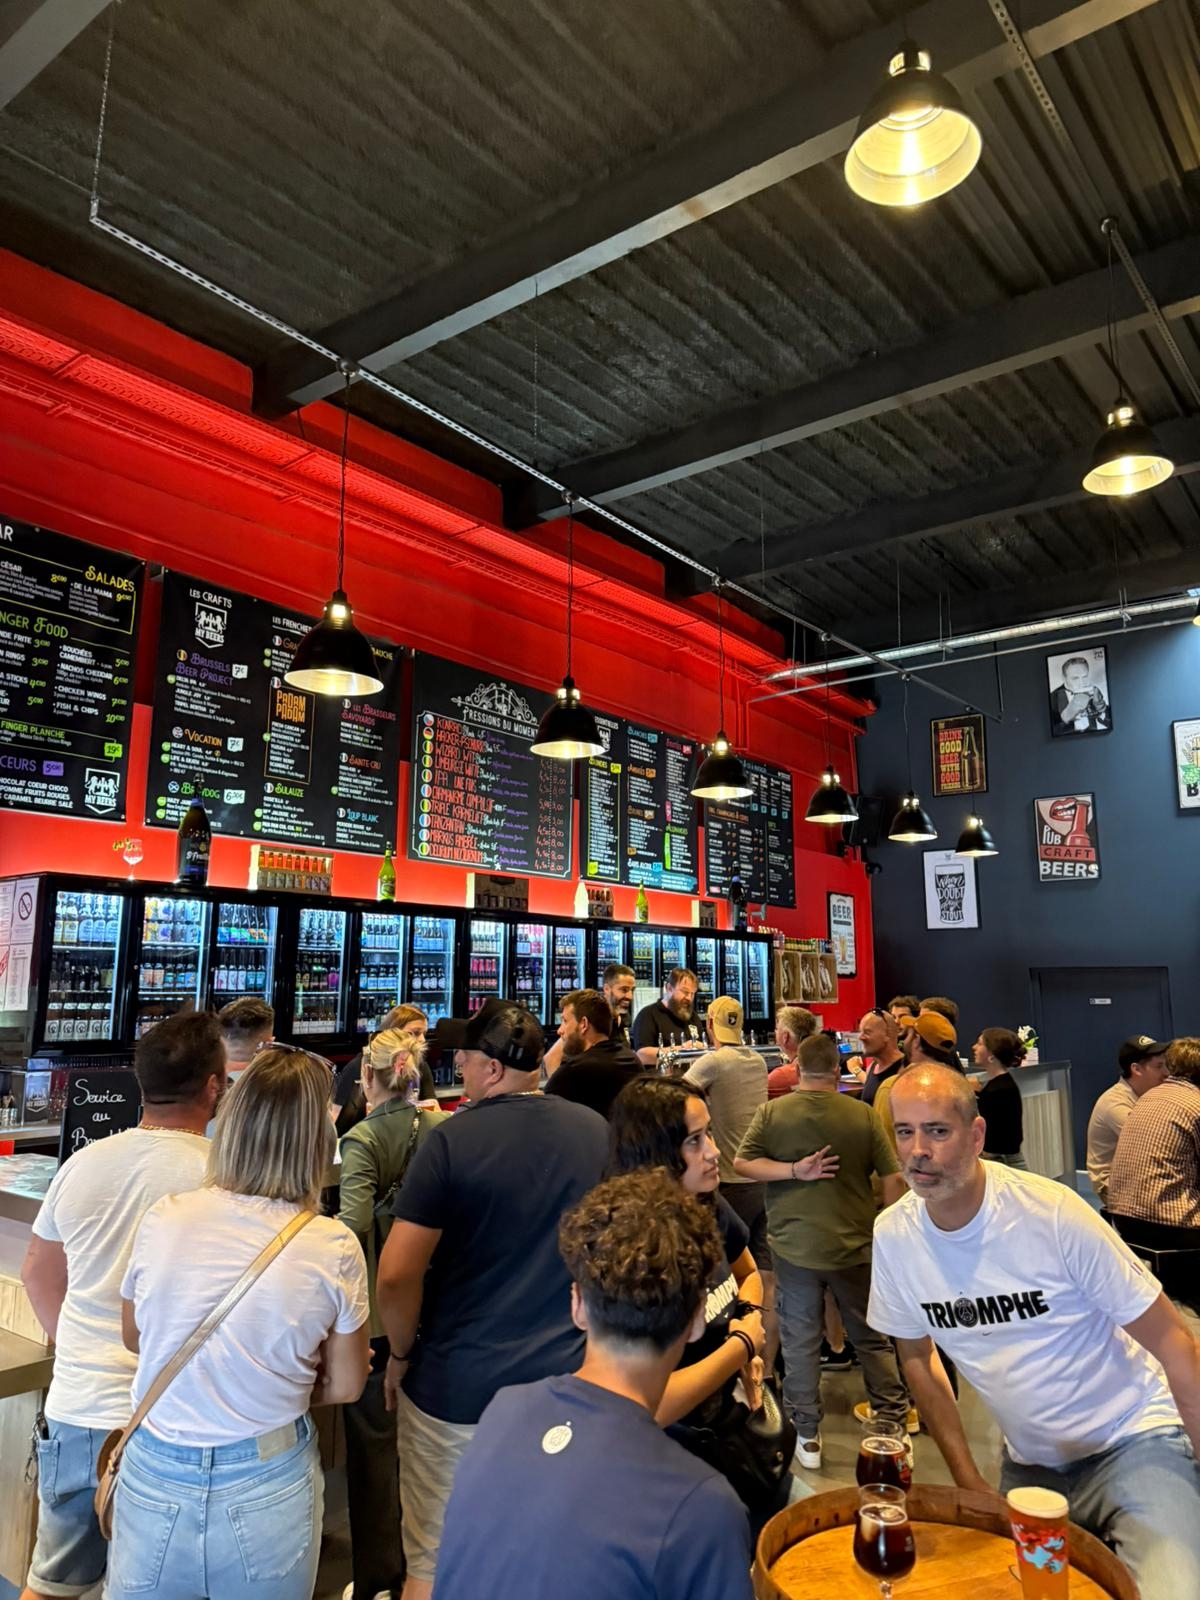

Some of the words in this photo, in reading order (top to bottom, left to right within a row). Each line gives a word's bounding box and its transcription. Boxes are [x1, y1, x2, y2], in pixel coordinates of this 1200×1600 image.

[0, 561, 22, 573] CÉSAR
[85, 565, 135, 592] SALADES
[73, 582, 83, 591] DE
[84, 584, 93, 592] LA
[93, 587, 113, 599] MAMA
[189, 588, 201, 599] LES
[202, 591, 233, 609] CRAFTS
[34, 617, 69, 638] FOOD
[272, 616, 281, 625] LES
[13, 632, 32, 644] FRITE
[195, 628, 205, 639] MY
[205, 631, 225, 643] BEERS
[5, 650, 26, 662] RINGS
[59, 652, 96, 666] CAMEMBERT
[62, 645, 93, 658] BOUCHÉES
[190, 652, 231, 672] BRUSSELS
[6, 673, 28, 684] STICKS
[60, 663, 84, 675] NACHOS
[85, 668, 113, 680] CHEDDAR
[175, 662, 198, 677] BEER
[200, 668, 234, 686] PROJECT
[58, 685, 85, 696] CHICKEN
[86, 689, 107, 701] WINGS
[277, 690, 306, 710] PADAM
[56, 702, 71, 711] FISH
[81, 706, 99, 716] CHIPS
[276, 704, 305, 723] PADAM
[363, 704, 396, 719] BRASSEURS
[463, 706, 501, 730] PRESSIONS
[503, 719, 512, 731] DU
[1, 720, 28, 733] FINGER
[30, 724, 65, 739] PLANCHE
[939, 730, 962, 742] DRINK
[184, 728, 223, 747] VOCATION
[940, 740, 961, 753] GOOD
[940, 753, 960, 764] BEER
[941, 772, 960, 784] GOOD
[24, 788, 46, 798] FRUITS
[46, 791, 70, 801] ROUGES
[27, 781, 47, 790] COEUR
[48, 784, 69, 793] CHOCO
[275, 783, 304, 798] SULAUZE
[3, 793, 33, 804] CARAMEL
[34, 797, 57, 807] BEURRE
[58, 799, 74, 809] SALÉ
[85, 794, 95, 804] MY
[96, 796, 117, 807] BEERS
[362, 812, 379, 823] BLANC
[1042, 824, 1061, 845] PUB
[1044, 847, 1092, 859] CRAFT
[1040, 861, 1098, 877] BEERS
[937, 886, 964, 900] DOUBT
[832, 904, 852, 919] BEER
[941, 910, 963, 921] STOUT
[73, 1078, 126, 1105] Service
[92, 1112, 111, 1122] au
